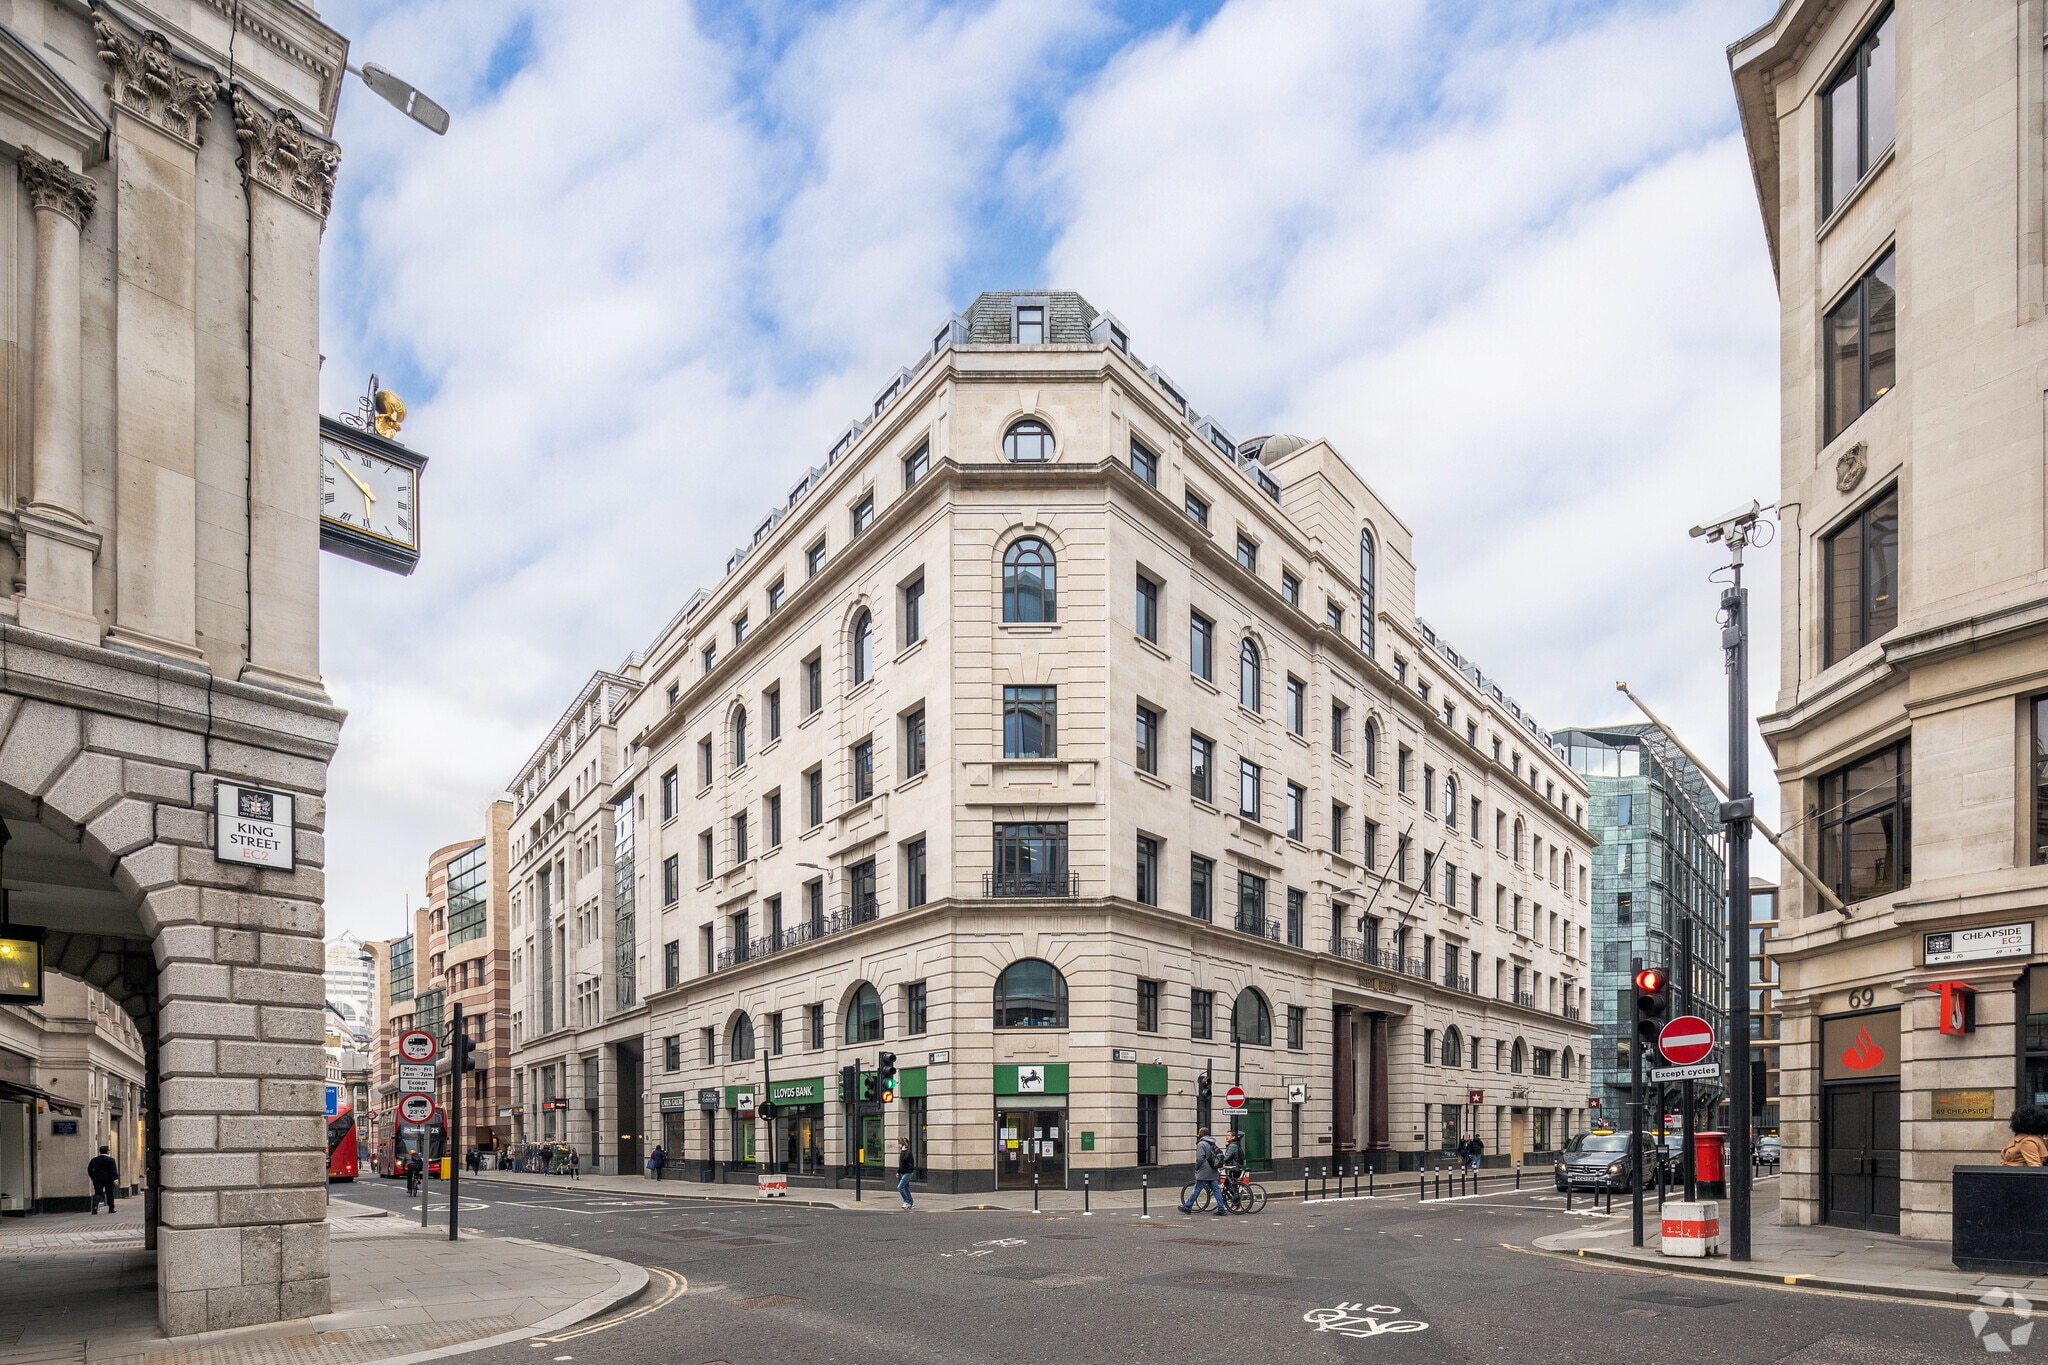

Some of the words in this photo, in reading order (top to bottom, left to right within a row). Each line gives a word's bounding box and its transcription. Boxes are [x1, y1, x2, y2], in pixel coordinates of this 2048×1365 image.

[238, 822, 274, 838] KING
[230, 834, 280, 850] STREET
[243, 848, 269, 860] EC2
[1962, 927, 2022, 940] CHEAPSIDE
[2002, 936, 2022, 945] EC2
[1848, 987, 1874, 1009] 69
[1655, 1069, 1685, 1078] Except
[1687, 1067, 1716, 1076] cycles
[774, 1087, 795, 1098] LLOYDS
[796, 1086, 812, 1097] BANK
